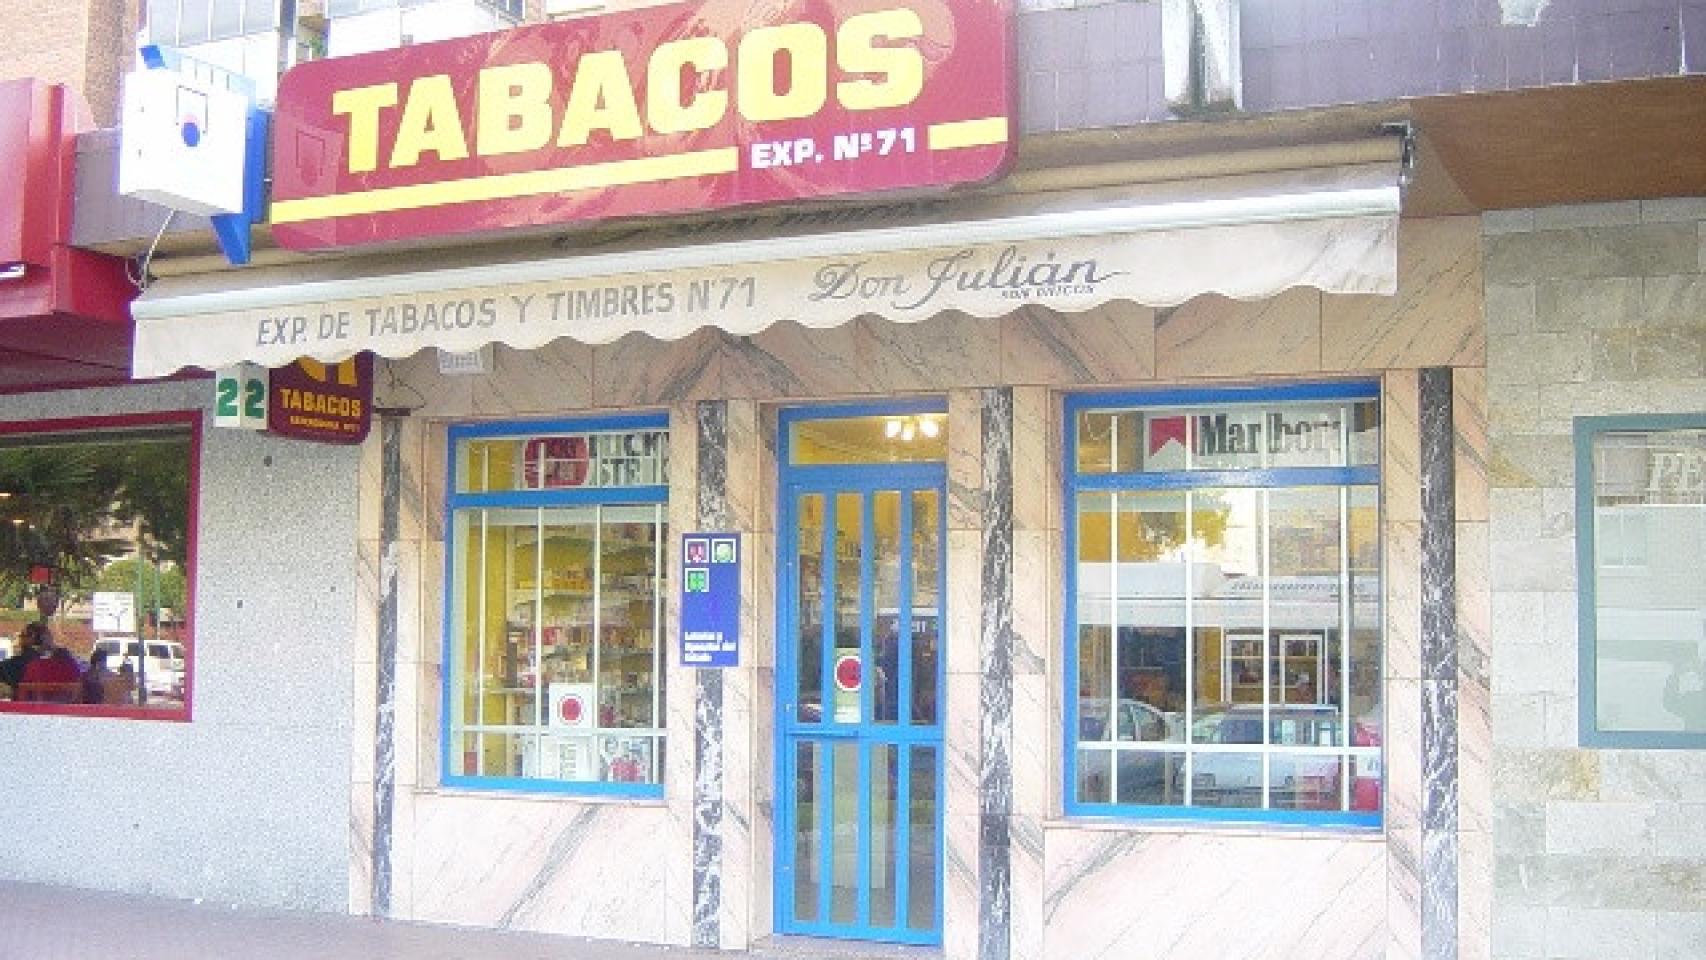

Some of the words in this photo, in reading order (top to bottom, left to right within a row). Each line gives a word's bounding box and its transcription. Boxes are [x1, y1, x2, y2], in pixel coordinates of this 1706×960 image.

[332, 8, 924, 174] TABACOS
[751, 138, 824, 169] EXP.
[808, 261, 911, 301] Don
[256, 315, 307, 346] EXP.
[318, 311, 350, 340] DE
[365, 298, 496, 337] TABACOS
[510, 293, 535, 323] Y
[547, 282, 675, 321] TIMBRES
[280, 388, 361, 417] TABACOS
